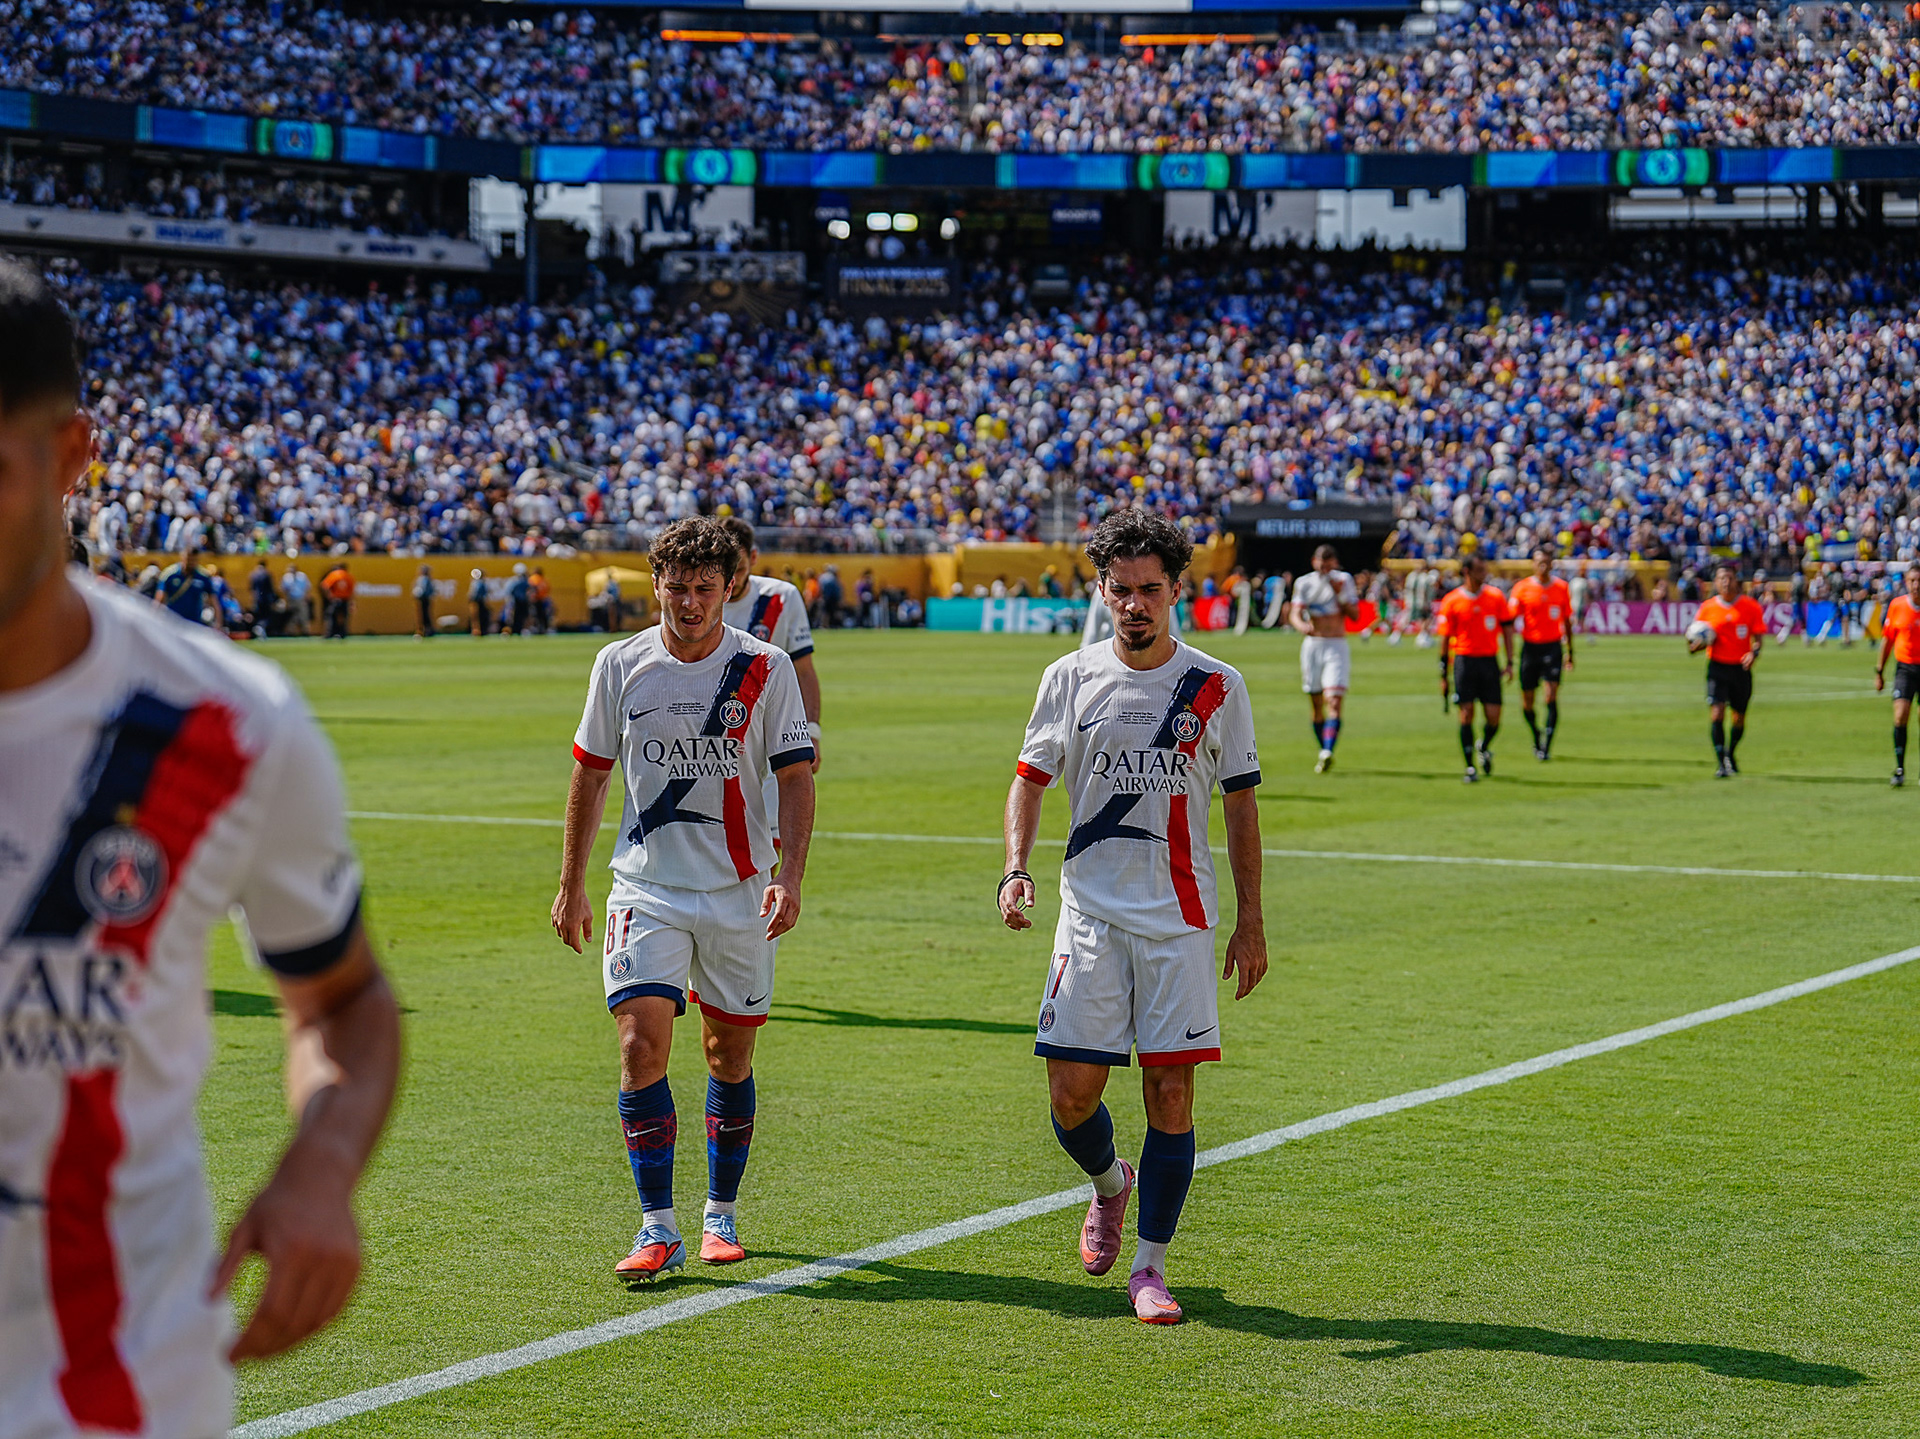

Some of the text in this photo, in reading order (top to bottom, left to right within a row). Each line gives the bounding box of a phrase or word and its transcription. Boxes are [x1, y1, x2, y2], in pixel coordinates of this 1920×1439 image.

[643, 738, 738, 767] QATAR
[668, 761, 738, 777] AIRWAYS
[1092, 750, 1187, 780] QATAR
[1112, 777, 1186, 794] AIRWAYS
